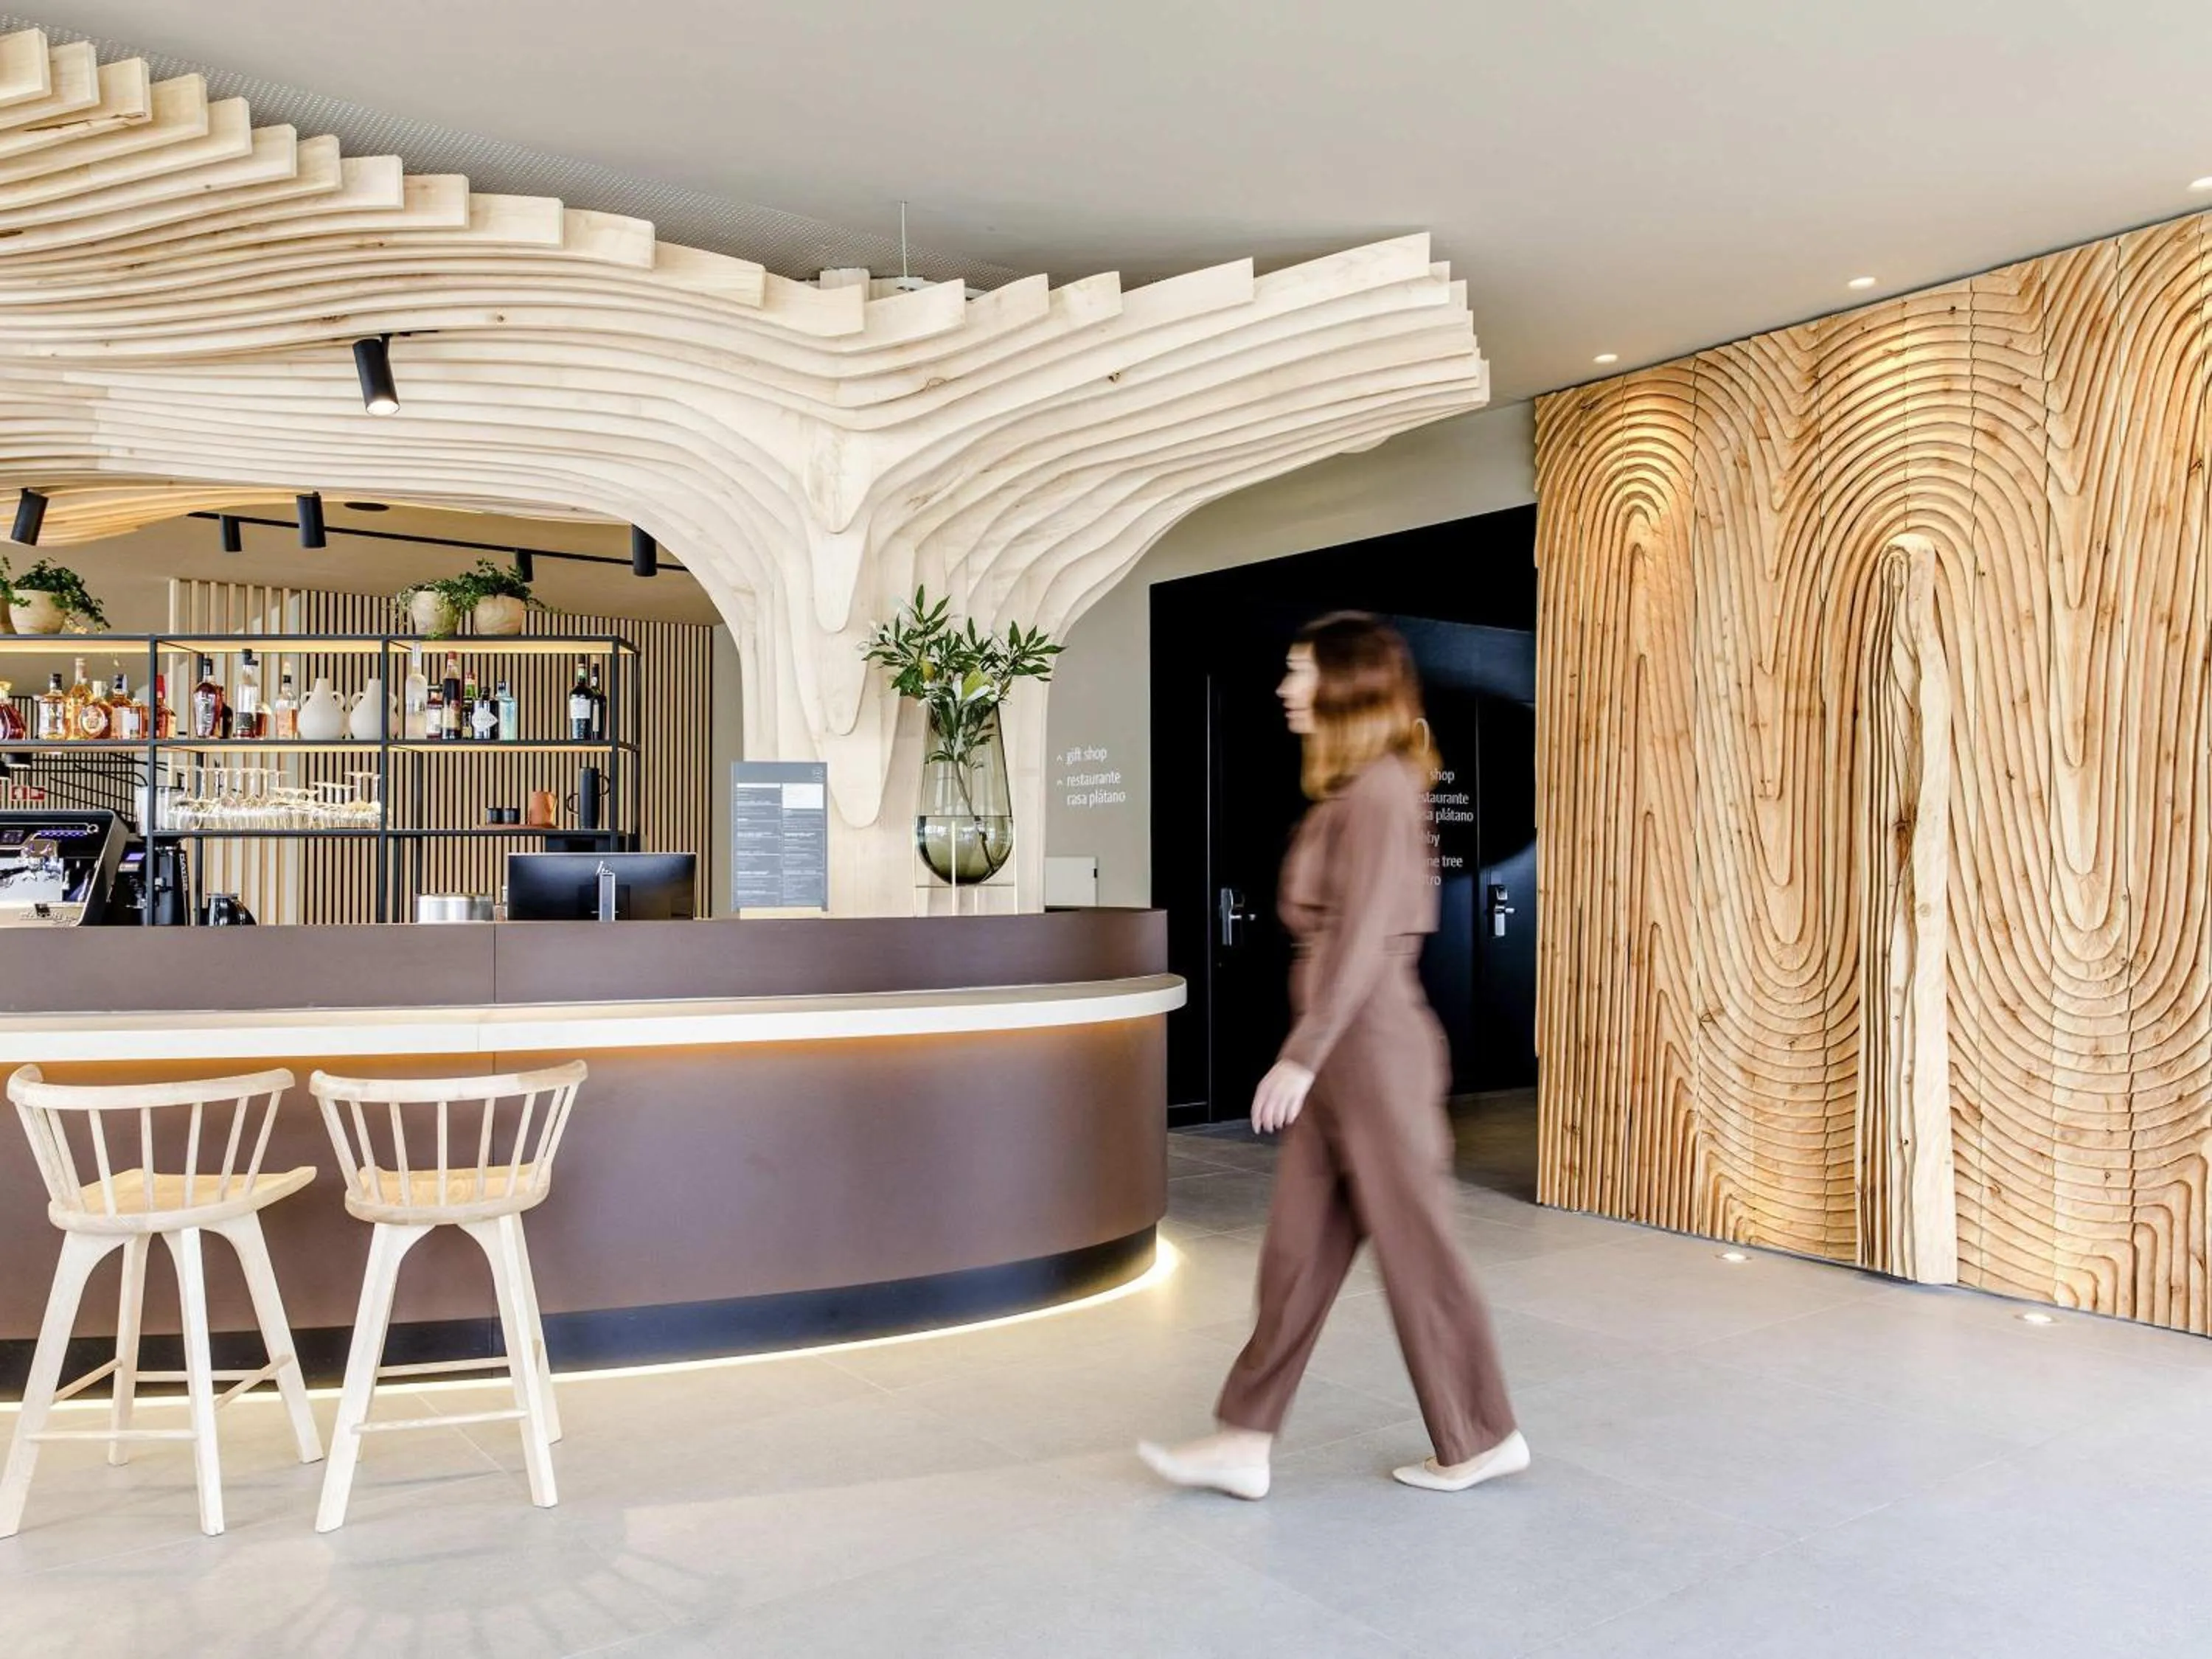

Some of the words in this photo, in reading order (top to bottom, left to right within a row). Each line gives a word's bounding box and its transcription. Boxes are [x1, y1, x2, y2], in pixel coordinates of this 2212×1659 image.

[1066, 747, 1081, 765] gift
[1084, 745, 1107, 762] shop
[1067, 771, 1121, 787] restaurante
[1089, 790, 1126, 808] plátano
[1436, 807, 1474, 824] plátano
[1441, 855, 1463, 868] tree
